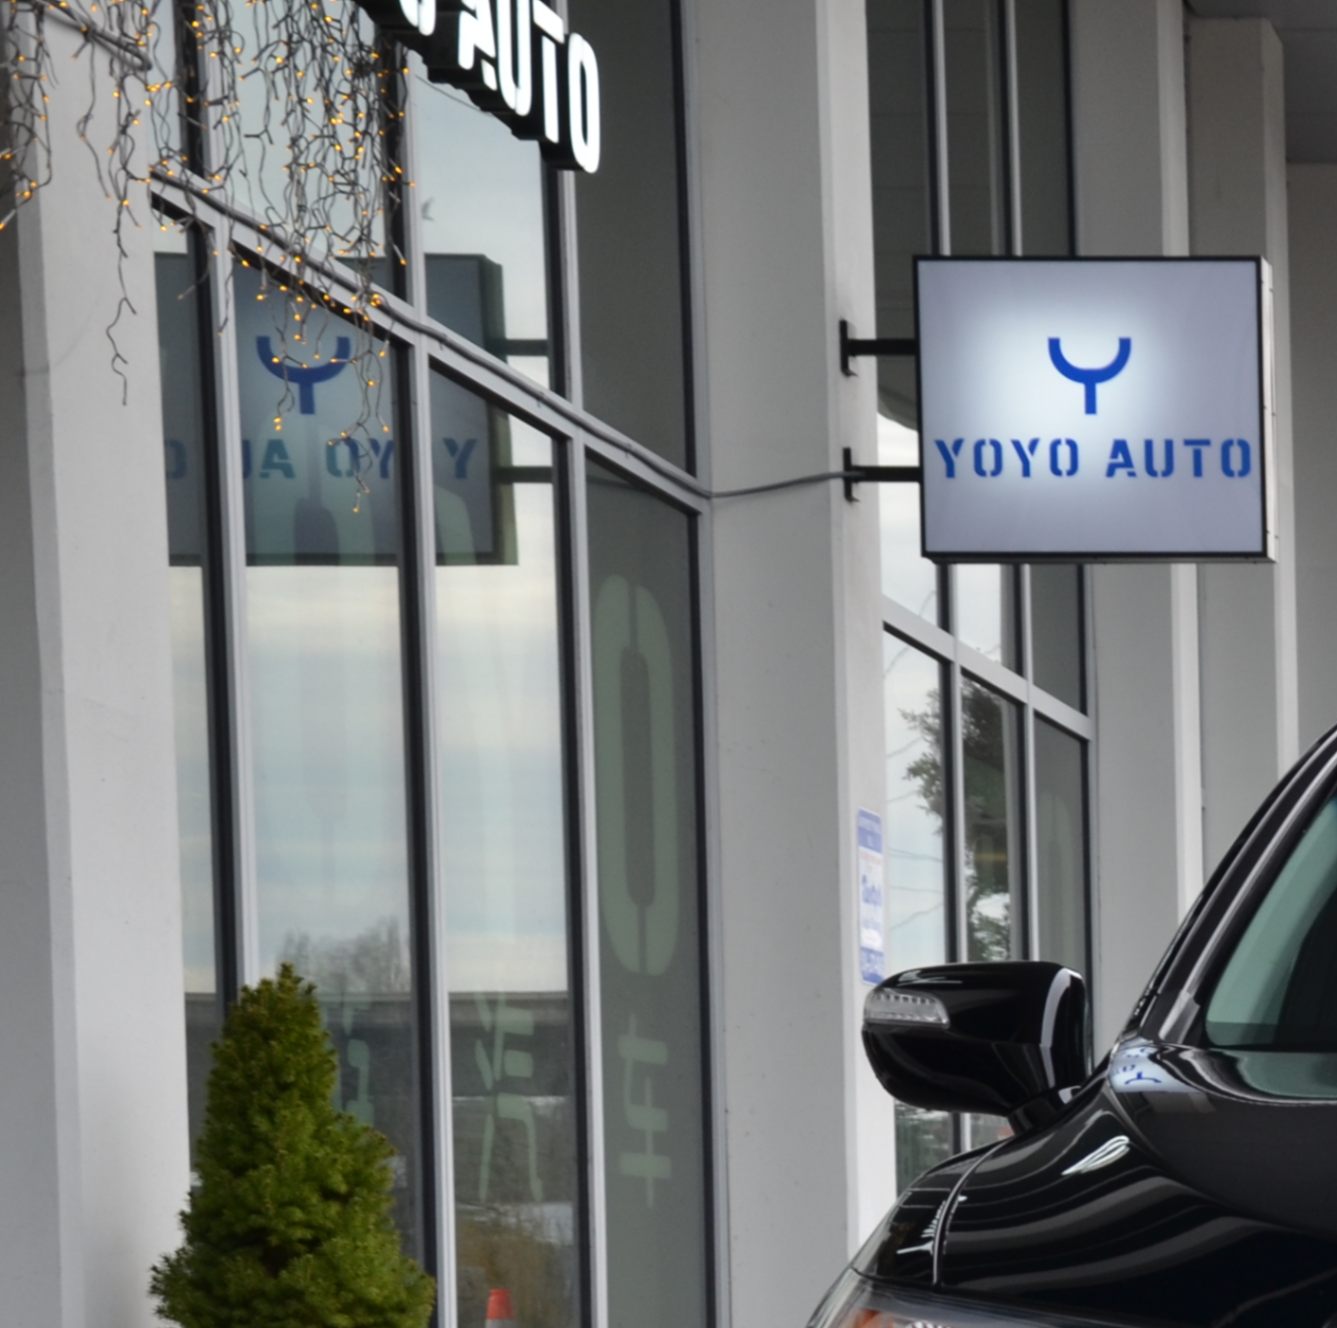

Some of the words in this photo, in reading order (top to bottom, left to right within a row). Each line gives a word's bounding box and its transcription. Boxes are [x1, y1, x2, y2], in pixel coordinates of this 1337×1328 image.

[457, 0, 600, 174] AUTO
[935, 437, 1079, 479] YOYO
[1106, 437, 1252, 479] AUTO
